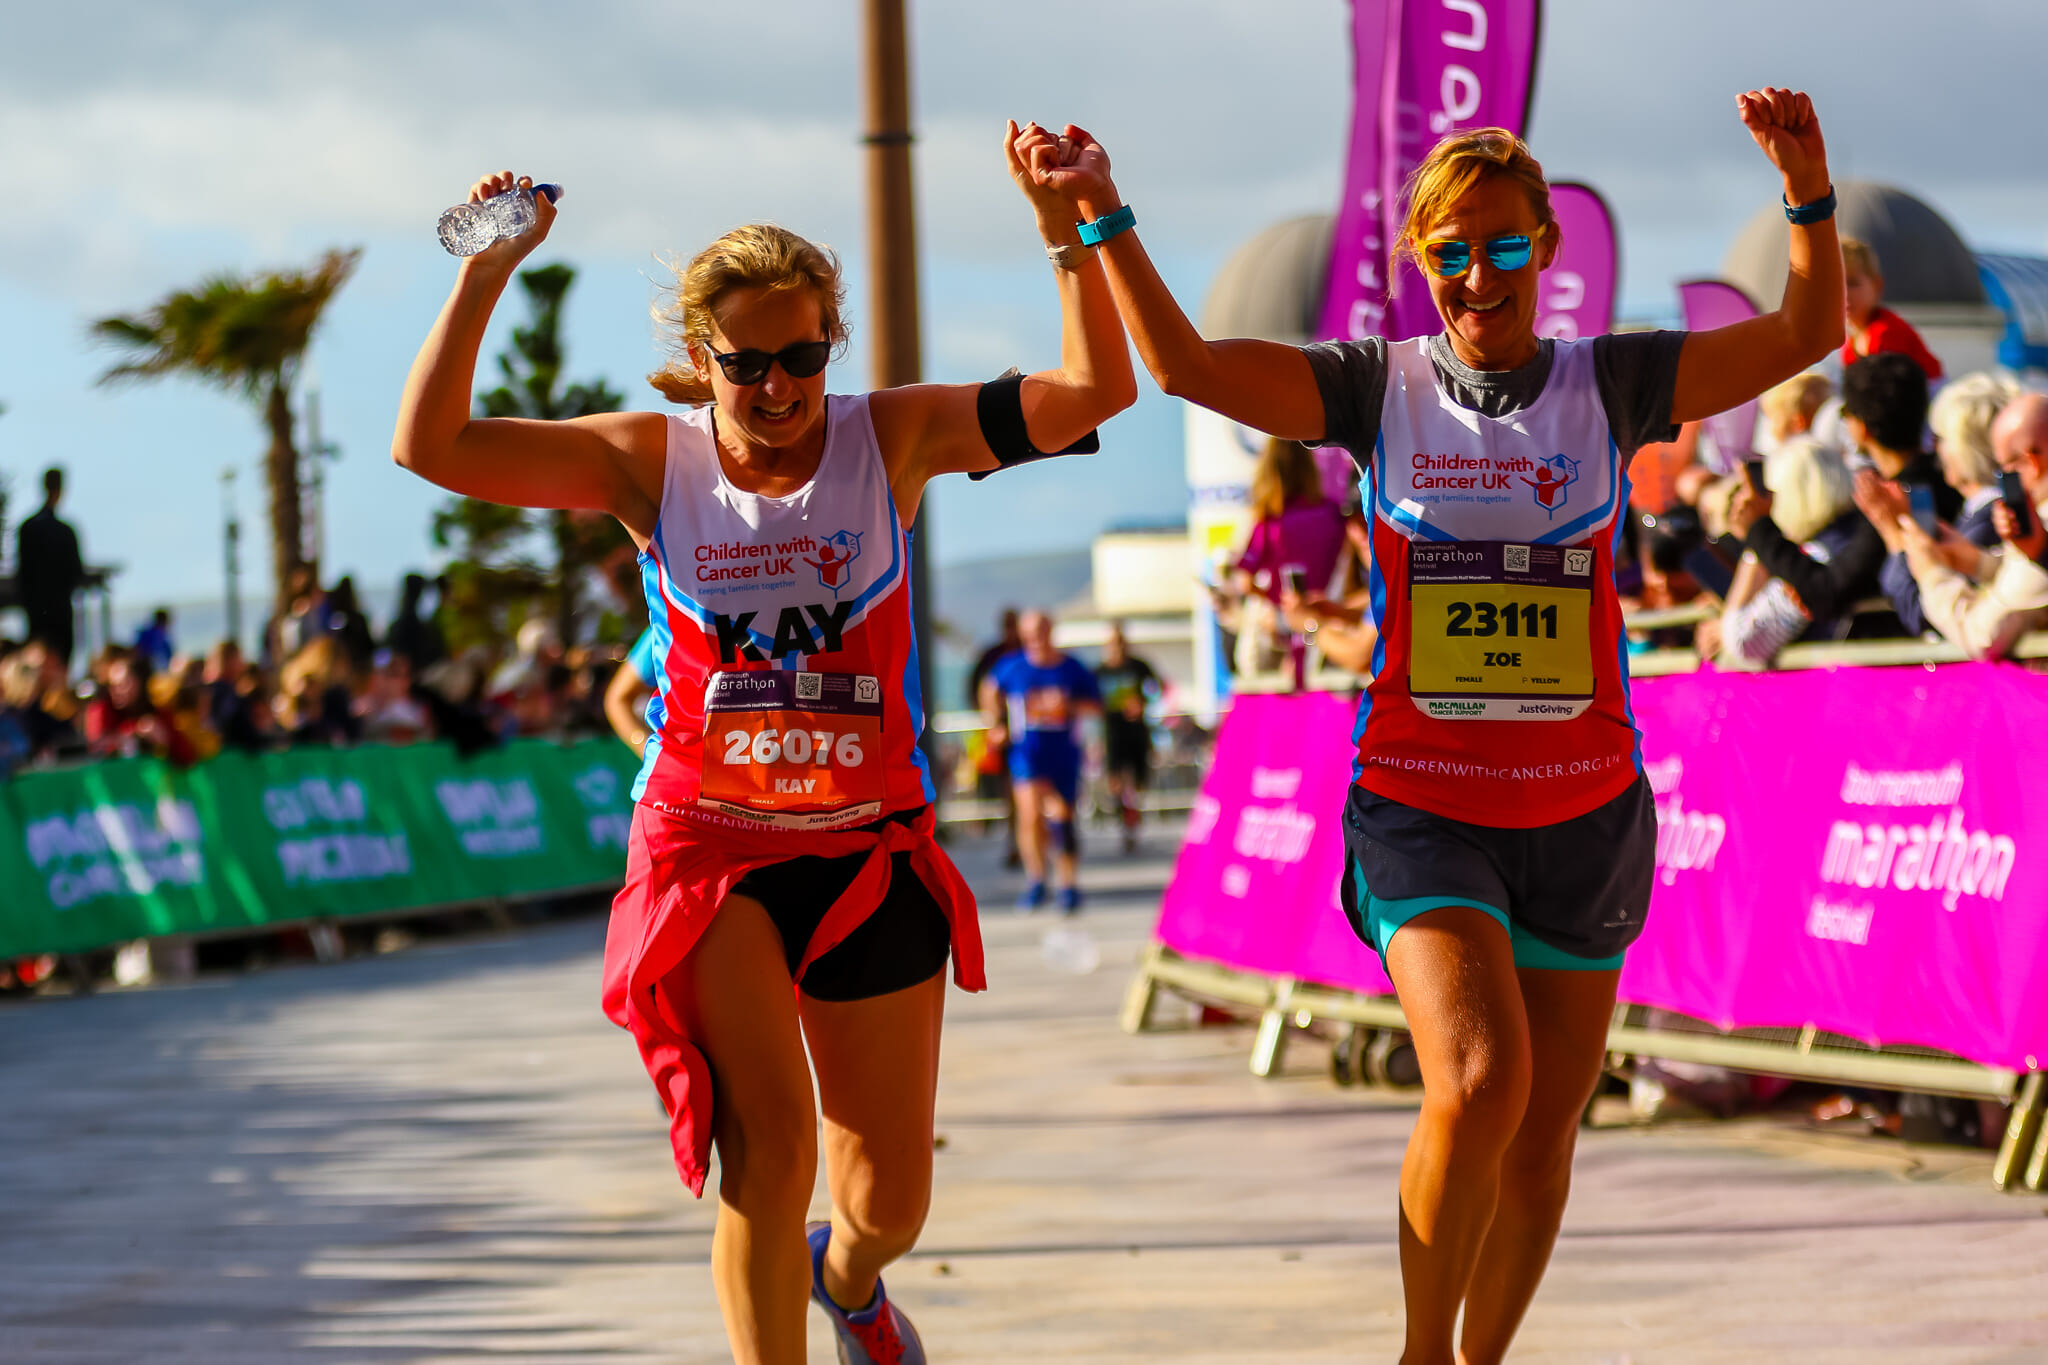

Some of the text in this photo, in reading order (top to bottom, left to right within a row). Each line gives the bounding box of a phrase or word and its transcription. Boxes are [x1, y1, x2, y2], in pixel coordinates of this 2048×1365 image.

[1411, 453, 1535, 473] Children with
[1411, 472, 1512, 490] Cancer UK
[1442, 493, 1474, 503] families
[1476, 494, 1512, 504] together
[694, 535, 817, 563] Children with
[1413, 550, 1484, 564] marathon
[696, 557, 795, 583] Cancer UK
[728, 583, 760, 595] families
[761, 580, 796, 592] together
[1446, 602, 1557, 639] 23111
[713, 600, 856, 664] KAY
[1483, 652, 1522, 667] ZOE
[1455, 676, 1483, 684] FEMALE
[1531, 677, 1561, 685] YELLOW
[1429, 701, 1486, 711] MACMILLAN
[1454, 709, 1482, 717] SUPPORT
[1517, 704, 1573, 716] JustGiving
[723, 728, 864, 768] 26076
[774, 778, 816, 794] KAY
[806, 808, 860, 825] JustGiving
[1820, 804, 2016, 912] marathon
